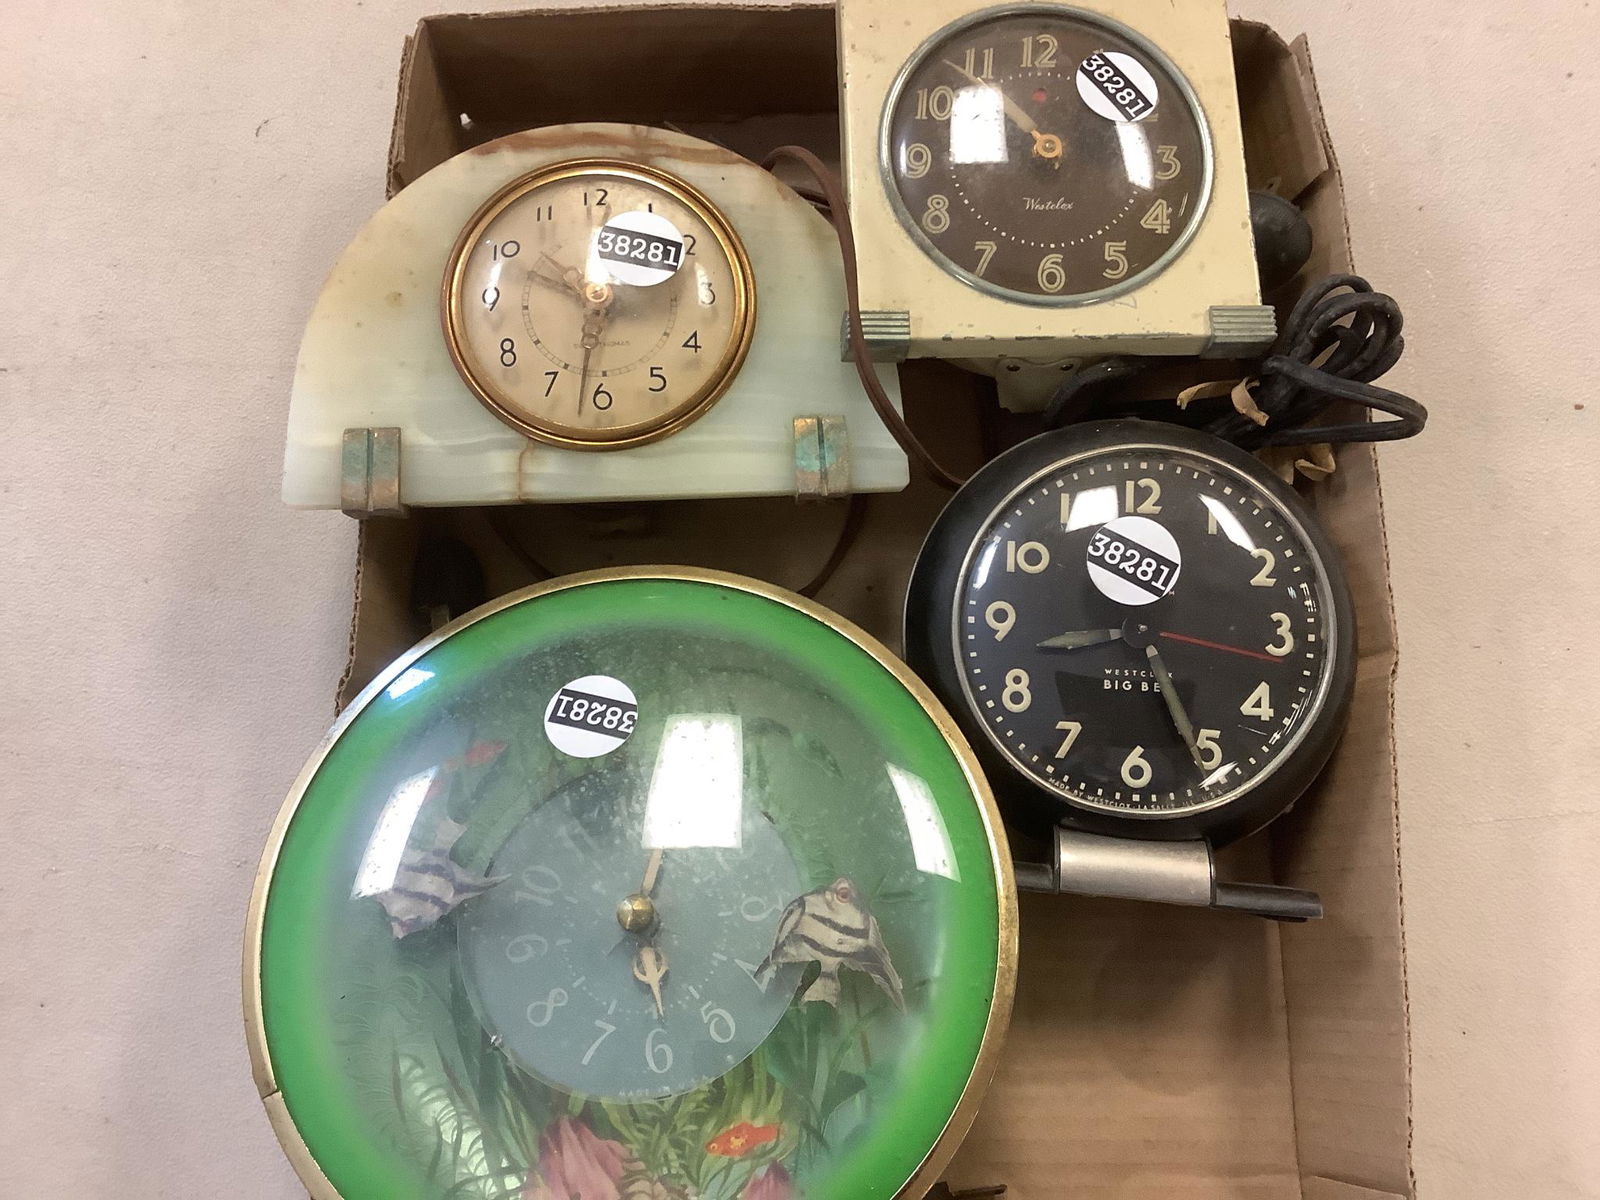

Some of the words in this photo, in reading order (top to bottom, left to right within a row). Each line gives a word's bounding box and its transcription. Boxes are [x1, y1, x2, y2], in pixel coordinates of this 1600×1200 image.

[964, 47, 994, 79] 11
[1020, 34, 1058, 68] 12
[915, 86, 954, 121] 10
[1081, 54, 1145, 117] 38281
[906, 143, 932, 179] 9
[1155, 145, 1181, 180] 3
[536, 205, 553, 222] 11
[584, 189, 608, 206] 12
[922, 194, 950, 234] 8
[1140, 199, 1171, 234] 4
[493, 240, 521, 261] 10
[598, 231, 679, 267] 38281
[683, 234, 697, 256] 2
[974, 241, 998, 277] 7
[1102, 241, 1128, 279] 5
[1037, 253, 1066, 293] 6
[482, 287, 500, 312] 9
[701, 282, 715, 305] 3
[500, 338, 517, 367] 8
[682, 330, 702, 353] 4
[544, 371, 559, 397] 7
[593, 383, 612, 410] 6
[648, 367, 667, 392] 5
[1125, 478, 1163, 515] 12
[1006, 540, 1050, 574] 10
[1087, 533, 1170, 591] 38281
[1250, 548, 1277, 587] 2
[985, 600, 1016, 641] 9
[1265, 612, 1294, 657] 3
[1001, 668, 1032, 713] 8
[1103, 679, 1132, 691] BIG
[1141, 681, 1161, 693] BE
[1104, 669, 1173, 679] WESTCLX
[557, 695, 638, 733] 38281
[1239, 681, 1275, 722] 4
[1055, 720, 1082, 759] 7
[1195, 728, 1223, 771] 5
[1120, 745, 1152, 788] 6
[515, 865, 561, 906] 10
[506, 934, 549, 963] 9
[527, 988, 568, 1027] 8
[700, 1001, 736, 1044] 5
[581, 1019, 617, 1065] 7
[645, 1028, 673, 1074] 6
